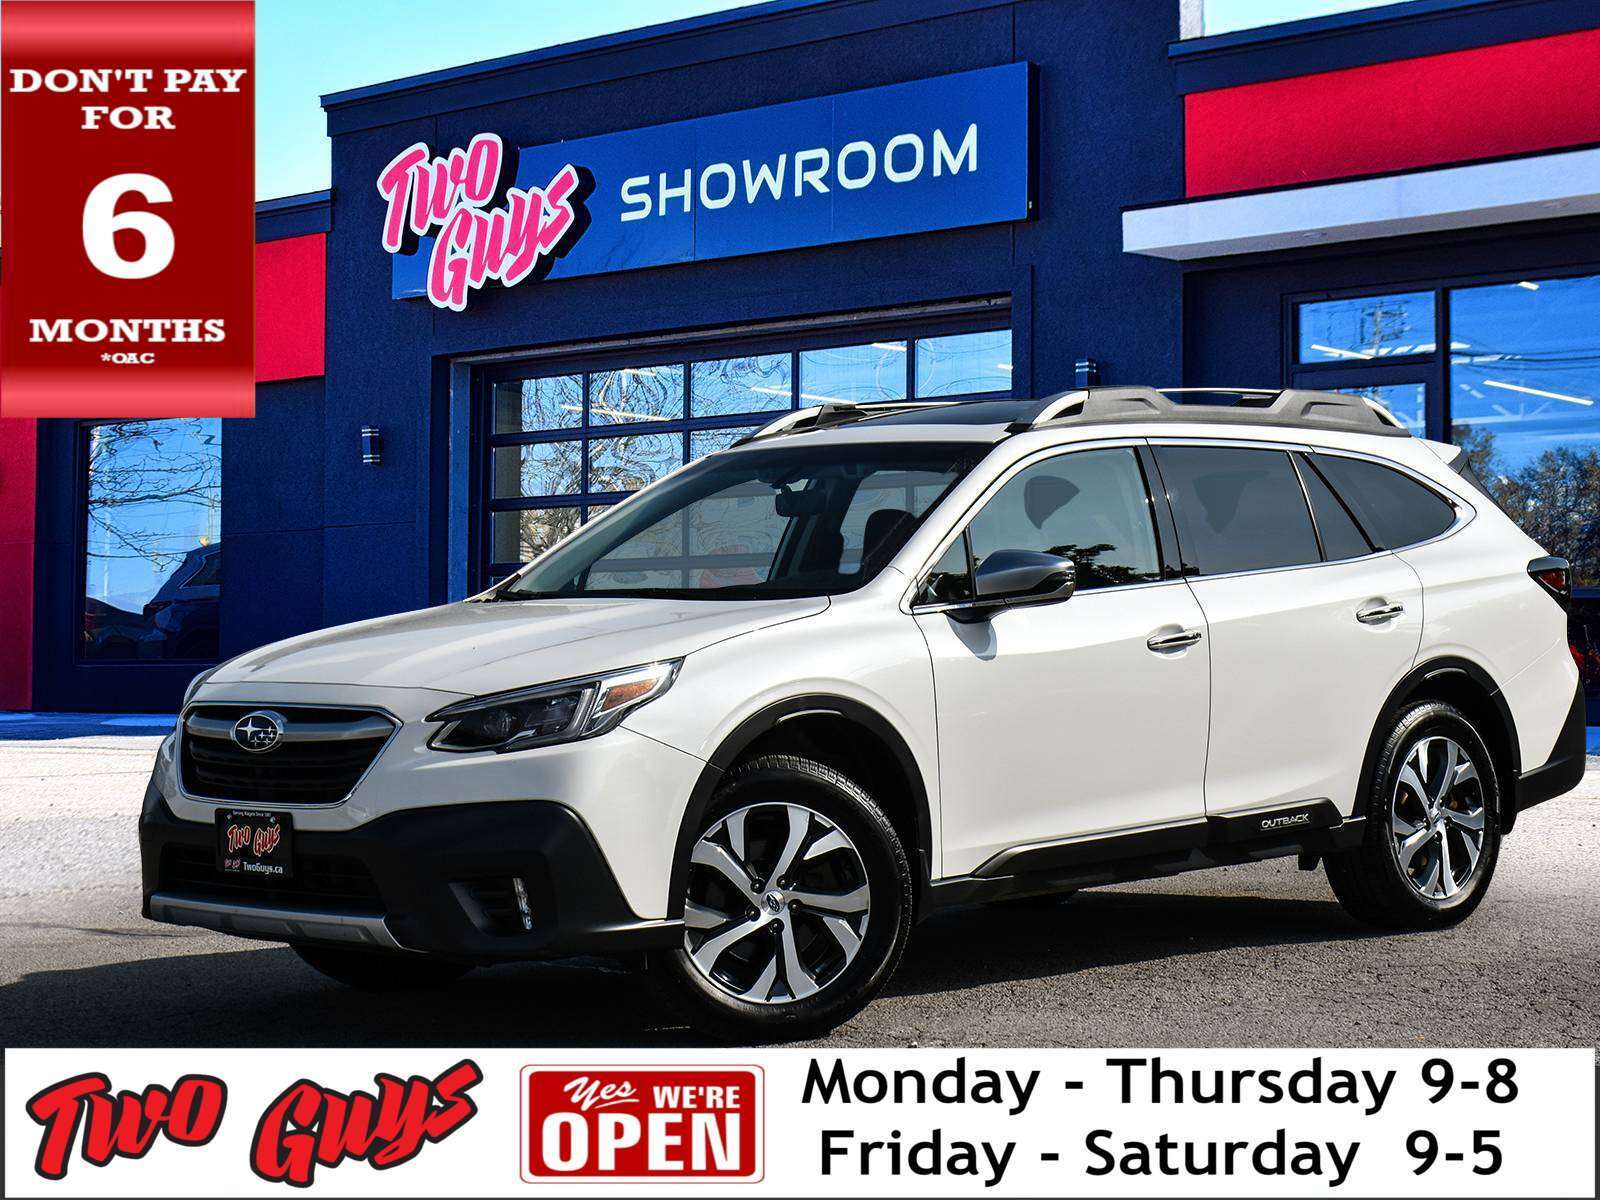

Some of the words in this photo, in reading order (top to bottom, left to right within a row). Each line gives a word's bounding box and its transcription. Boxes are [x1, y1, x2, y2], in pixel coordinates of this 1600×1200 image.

[620, 123, 977, 222] SHOWROOM
[1261, 813, 1309, 828] OUTBACK
[243, 861, 283, 875] TwoGuys.ca
